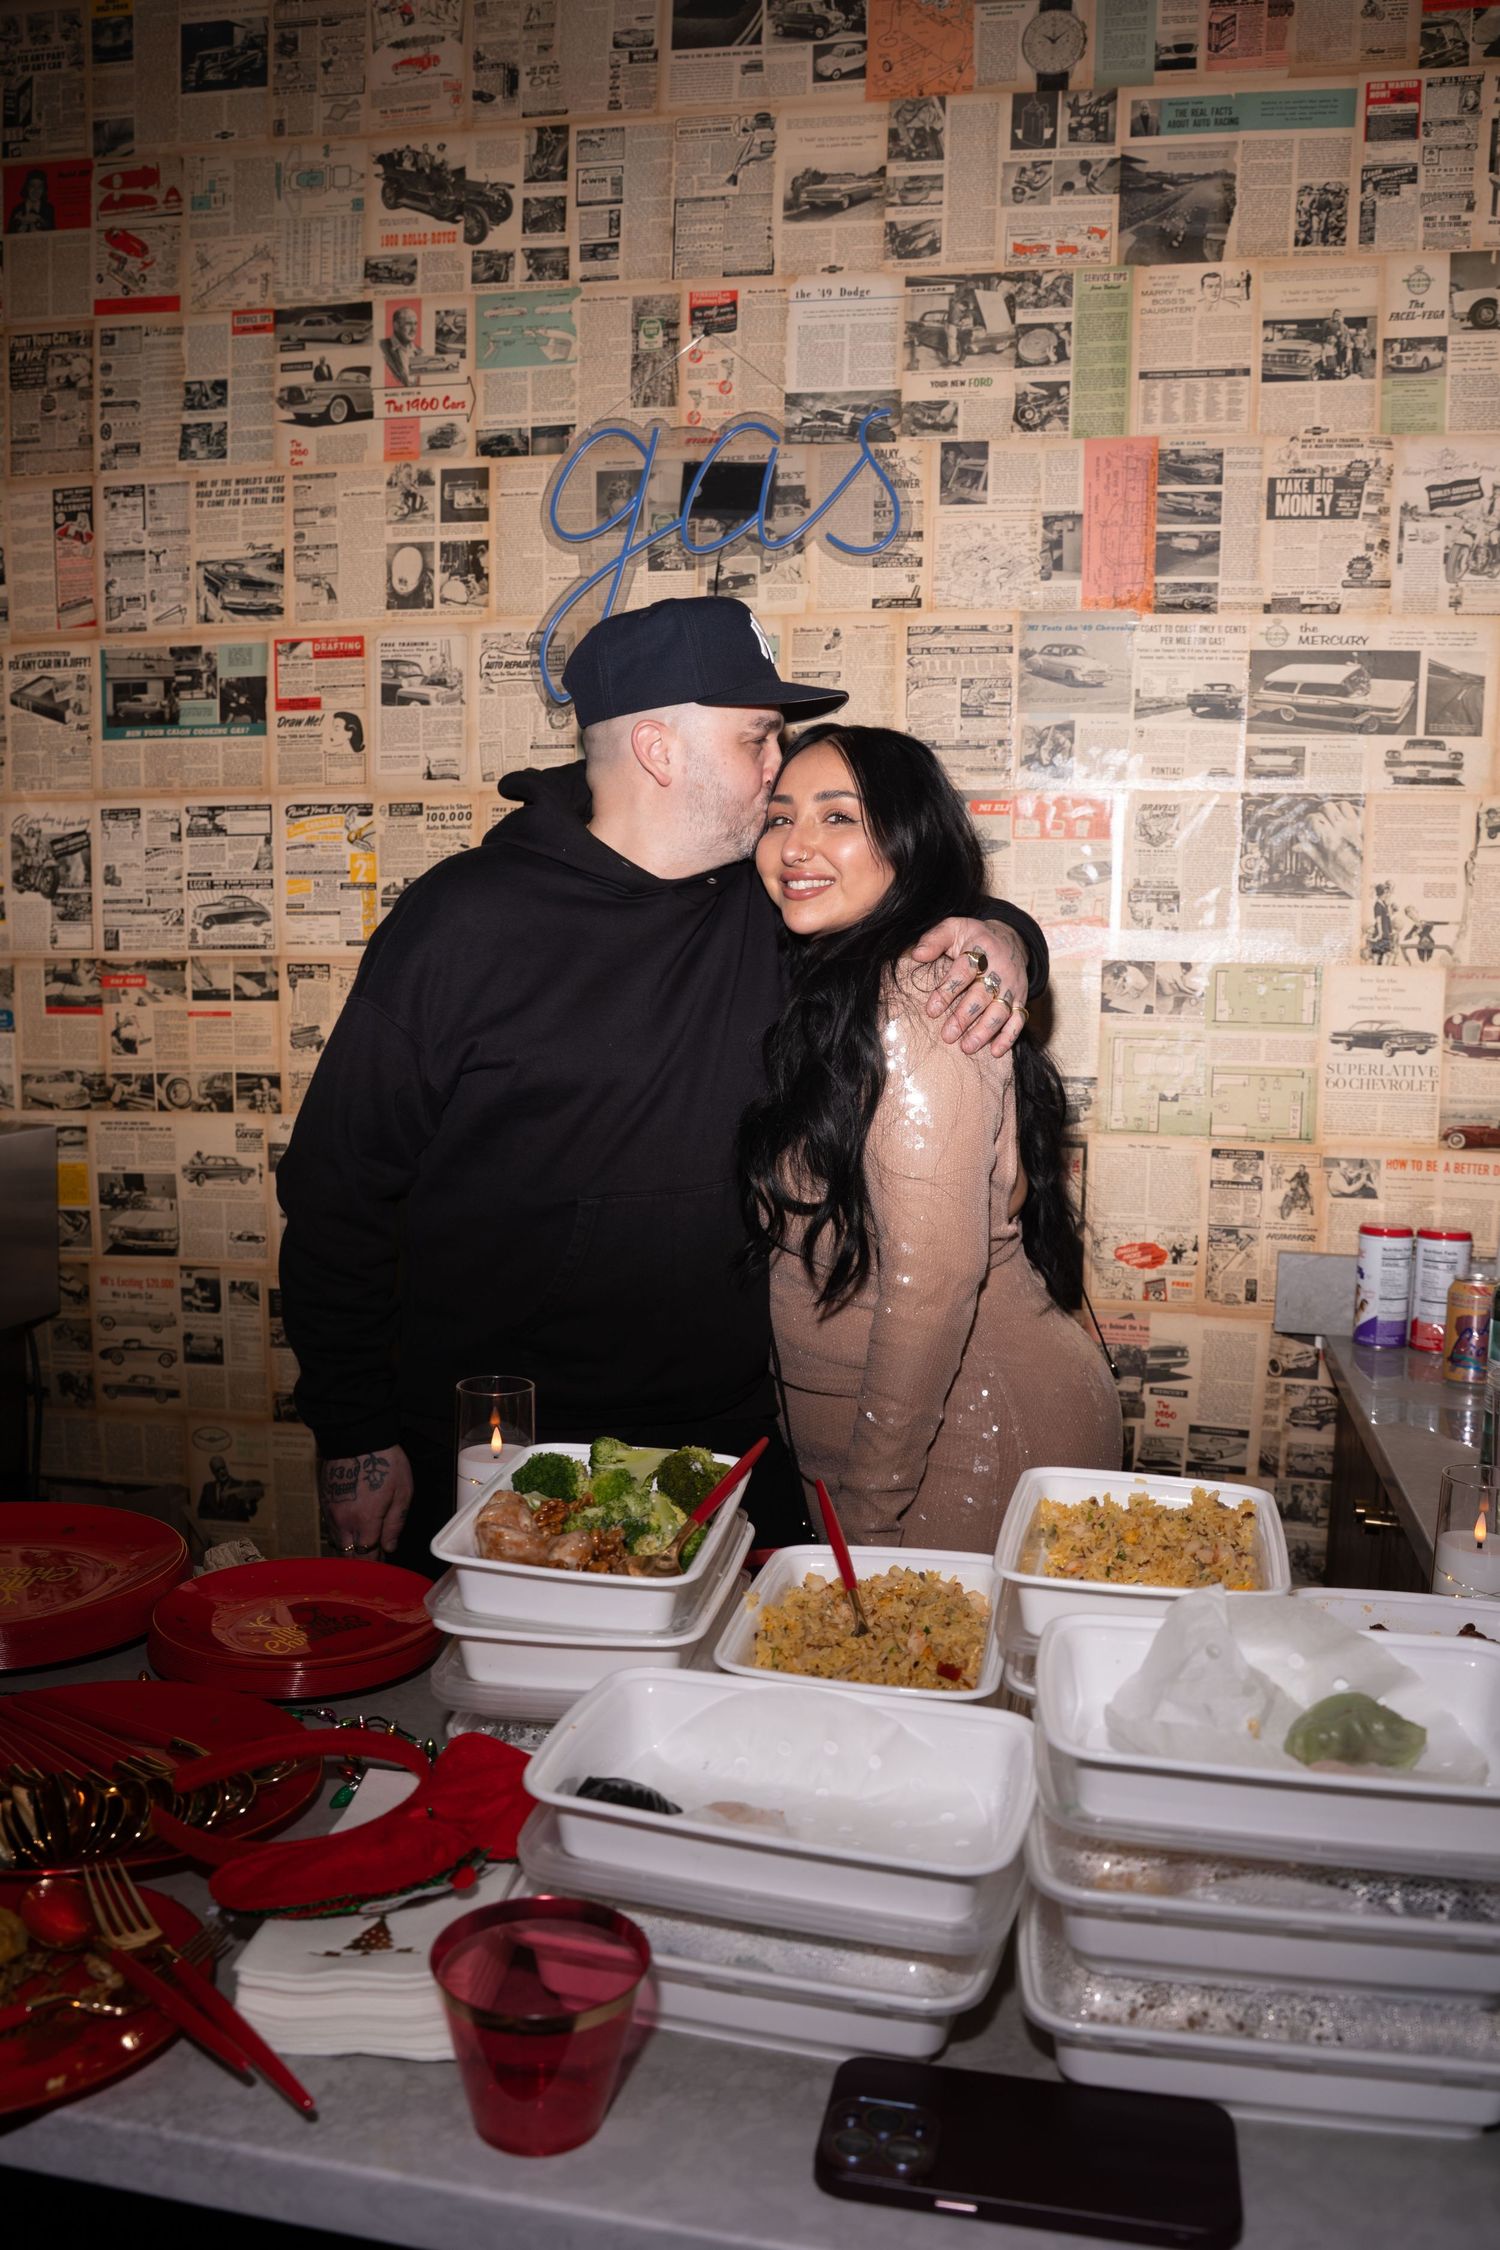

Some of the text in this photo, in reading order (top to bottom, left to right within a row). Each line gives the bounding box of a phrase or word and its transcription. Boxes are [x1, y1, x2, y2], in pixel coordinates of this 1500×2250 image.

[1175, 106, 1233, 117] THE REAL FACTS
[1168, 116, 1239, 128] ABOUT AUTO RACING
[795, 290, 811, 299] the
[840, 287, 871, 298] Dodge
[1409, 300, 1425, 309] The
[1140, 306, 1196, 315] DAUGHTER?
[1389, 310, 1445, 321] FACEL-VEGA
[930, 377, 993, 388] YOUR NEW FORD
[385, 395, 466, 414] The 1960 Cars
[874, 449, 899, 459] BALKY
[196, 475, 285, 489] ONE OF THE WORLD'S GREAT
[890, 478, 920, 489] MOWER
[1276, 478, 1334, 493] MAKE BIG
[195, 486, 285, 498] ROAD CARS IS INVITING YOU
[196, 500, 204, 508] TO
[207, 499, 225, 507] COME
[228, 498, 240, 506] FOR
[251, 497, 268, 505] TRIAL
[272, 496, 285, 504] RUN
[1275, 494, 1334, 516] MONEY
[540, 408, 893, 703] gas
[1141, 625, 1162, 633] COAST
[1164, 625, 1173, 633] TO
[1175, 625, 1198, 633] COAST
[1300, 622, 1318, 633] the
[1160, 636, 1173, 645] PER
[1176, 636, 1191, 645] MILE
[1298, 635, 1369, 646] MERCURY
[314, 642, 361, 651] DRAFTING
[9, 660, 19, 671] FIX
[22, 660, 36, 670] ANY
[38, 659, 52, 669] CAR
[70, 656, 91, 668] JIFFY!
[484, 660, 530, 669] AUTO REPAIR
[277, 714, 326, 728] Draw Me!
[426, 812, 472, 822] 100,000
[1326, 1063, 1439, 1078] SUPERLATIVE
[1348, 1077, 1439, 1092] CHEVROLET
[1386, 1160, 1489, 1176] HOW TO BE A BETTER
[1266, 1233, 1316, 1242] HUMMER
